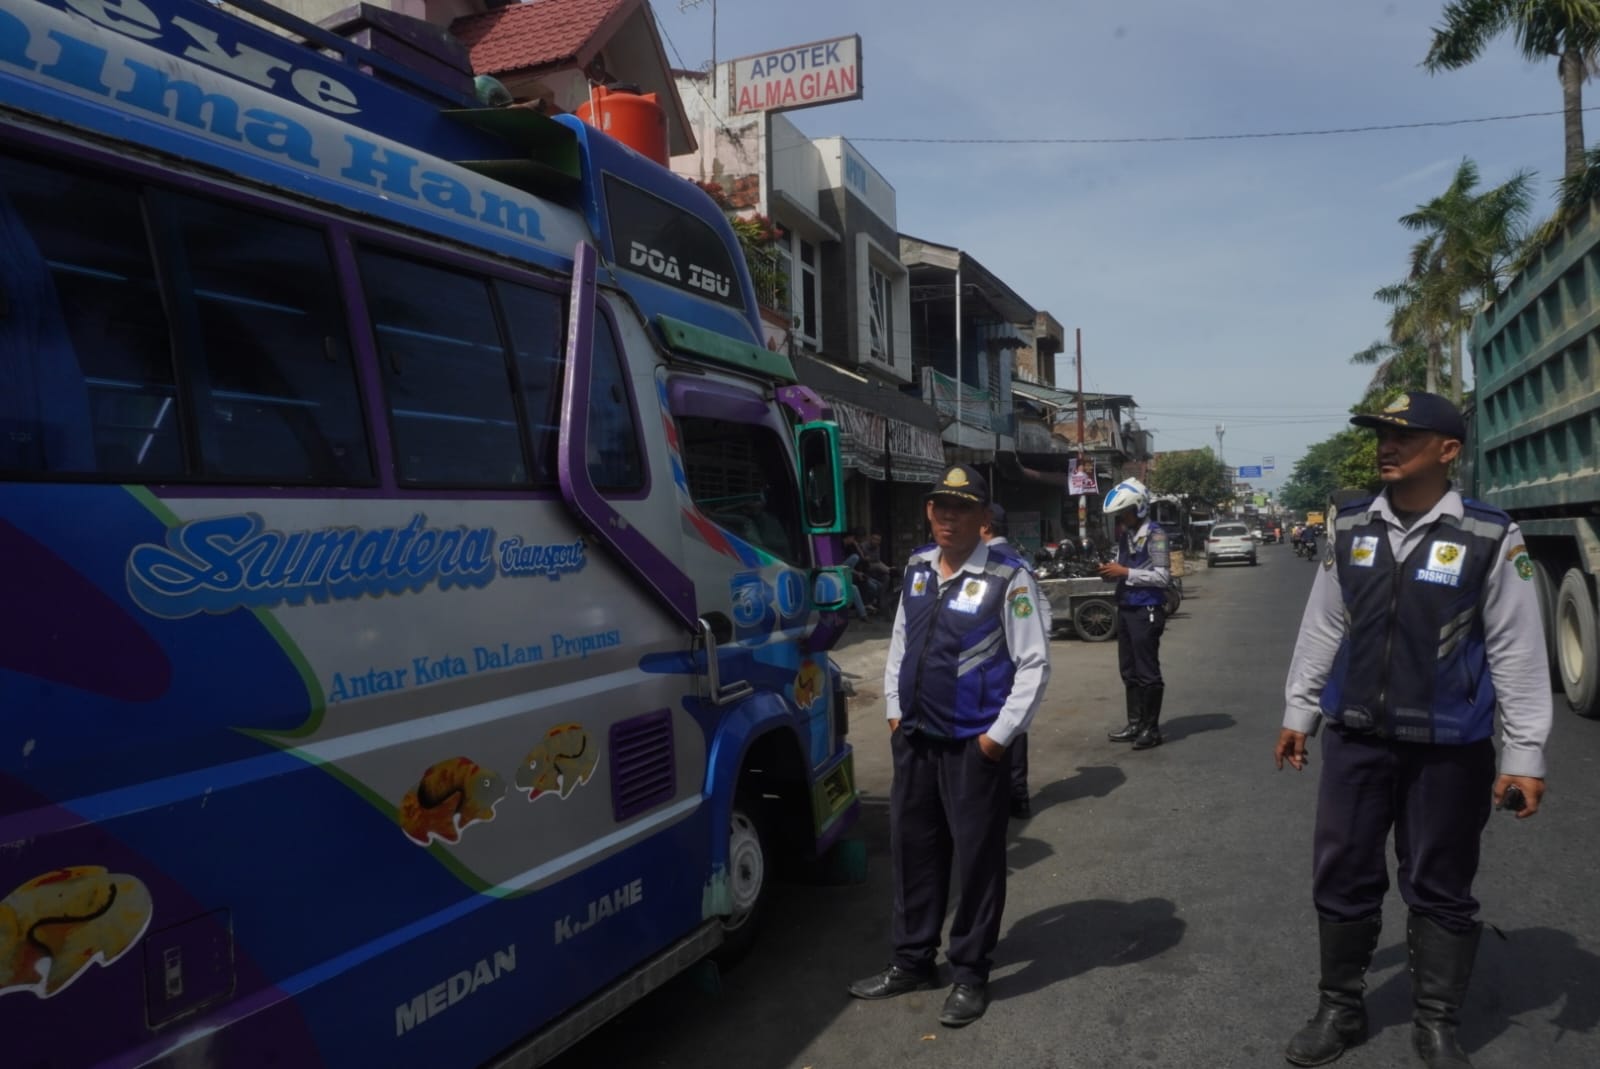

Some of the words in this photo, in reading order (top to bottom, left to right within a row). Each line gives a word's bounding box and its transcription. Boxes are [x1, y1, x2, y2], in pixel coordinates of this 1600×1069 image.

[750, 42, 841, 80] APOTEK
[341, 134, 547, 242] Ham
[629, 241, 681, 280] DOA
[688, 264, 731, 298] IBU
[127, 511, 497, 616] Sumatera
[498, 536, 588, 580] Transport
[1416, 568, 1459, 587] DISHUB
[328, 667, 408, 704] Antar
[413, 653, 468, 686] Kota
[554, 878, 643, 945] K.JAHE
[395, 943, 517, 1038] MEDAN
